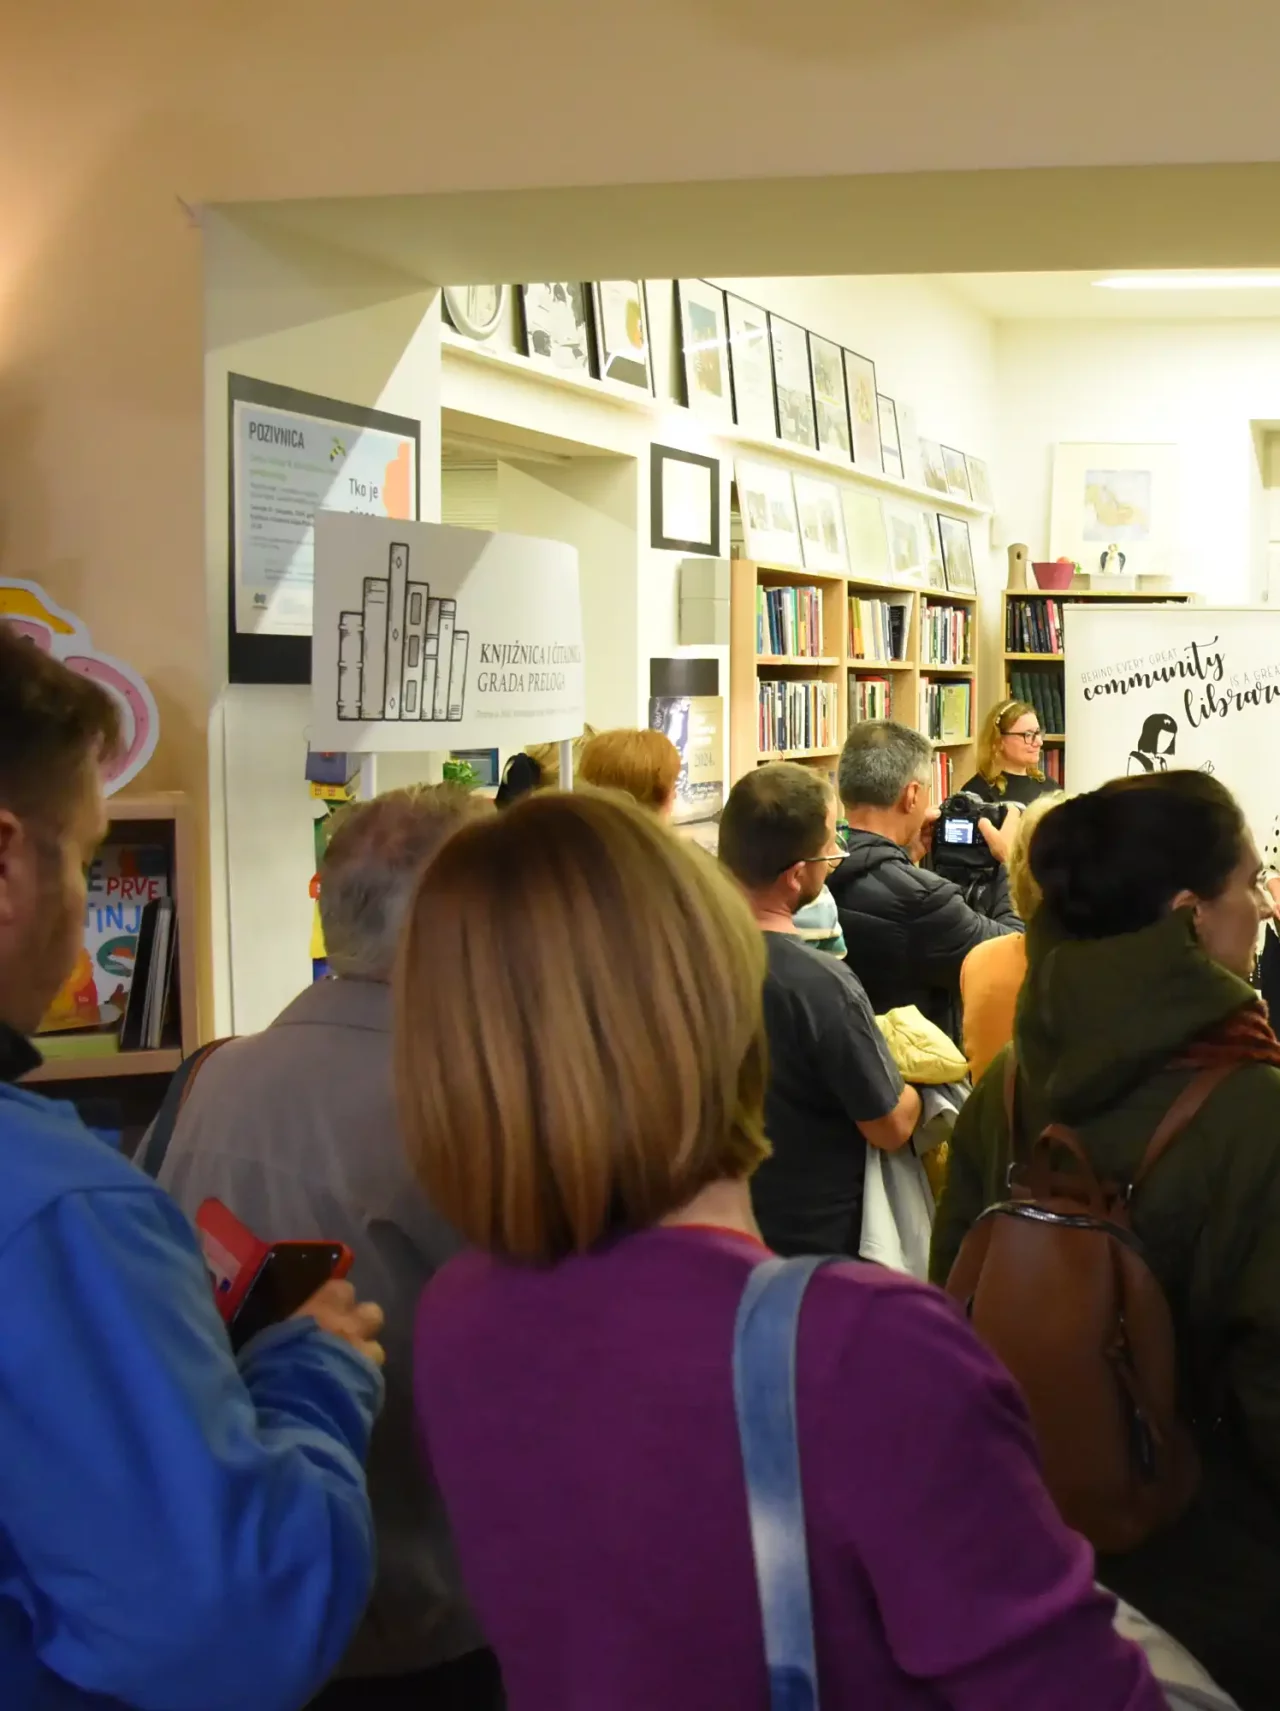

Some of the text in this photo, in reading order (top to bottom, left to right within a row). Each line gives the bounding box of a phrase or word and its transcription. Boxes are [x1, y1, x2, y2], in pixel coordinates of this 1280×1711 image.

[249, 421, 305, 449] POZIVNICA
[349, 478, 379, 502] Tko je
[480, 640, 545, 669] KNJIŽNICA
[1081, 648, 1178, 684] BEHIND EVERY GREAT
[1084, 635, 1226, 701] community
[477, 672, 525, 692] GRADA
[1229, 675, 1240, 689] IS
[106, 876, 159, 901] PRVE
